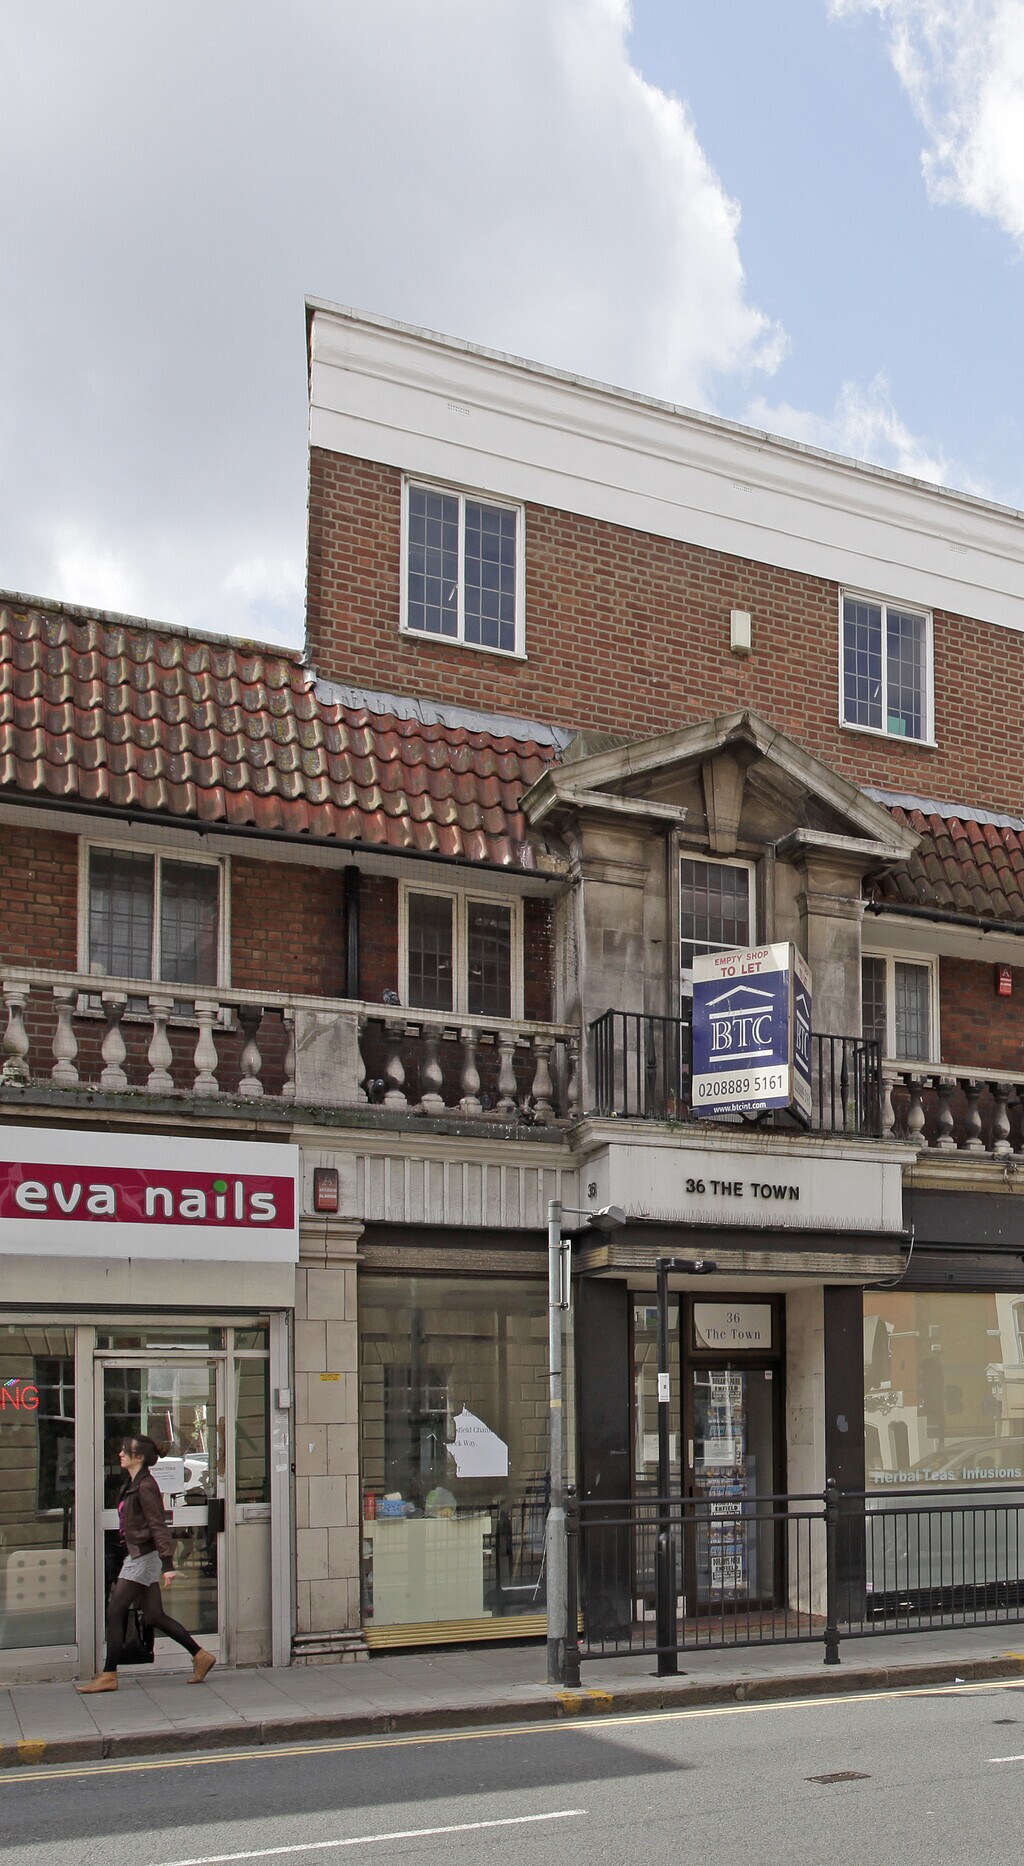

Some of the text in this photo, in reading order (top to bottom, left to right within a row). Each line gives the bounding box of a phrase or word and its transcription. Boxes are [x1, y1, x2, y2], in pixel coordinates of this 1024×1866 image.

[714, 950, 768, 966] EMPTY SHOP
[721, 962, 762, 977] TO LET
[711, 1014, 772, 1051] BTC
[698, 1078, 750, 1097] 0208889
[754, 1074, 783, 1091] 5161
[714, 1101, 767, 1114] www.btcint.com
[686, 1179, 800, 1200] 36 THE TOWN
[15, 1179, 277, 1222] eva nails
[726, 1312, 740, 1323] 36
[705, 1329, 761, 1339] The Town
[922, 1468, 955, 1481] Teas
[962, 1467, 1022, 1479] Infusions
